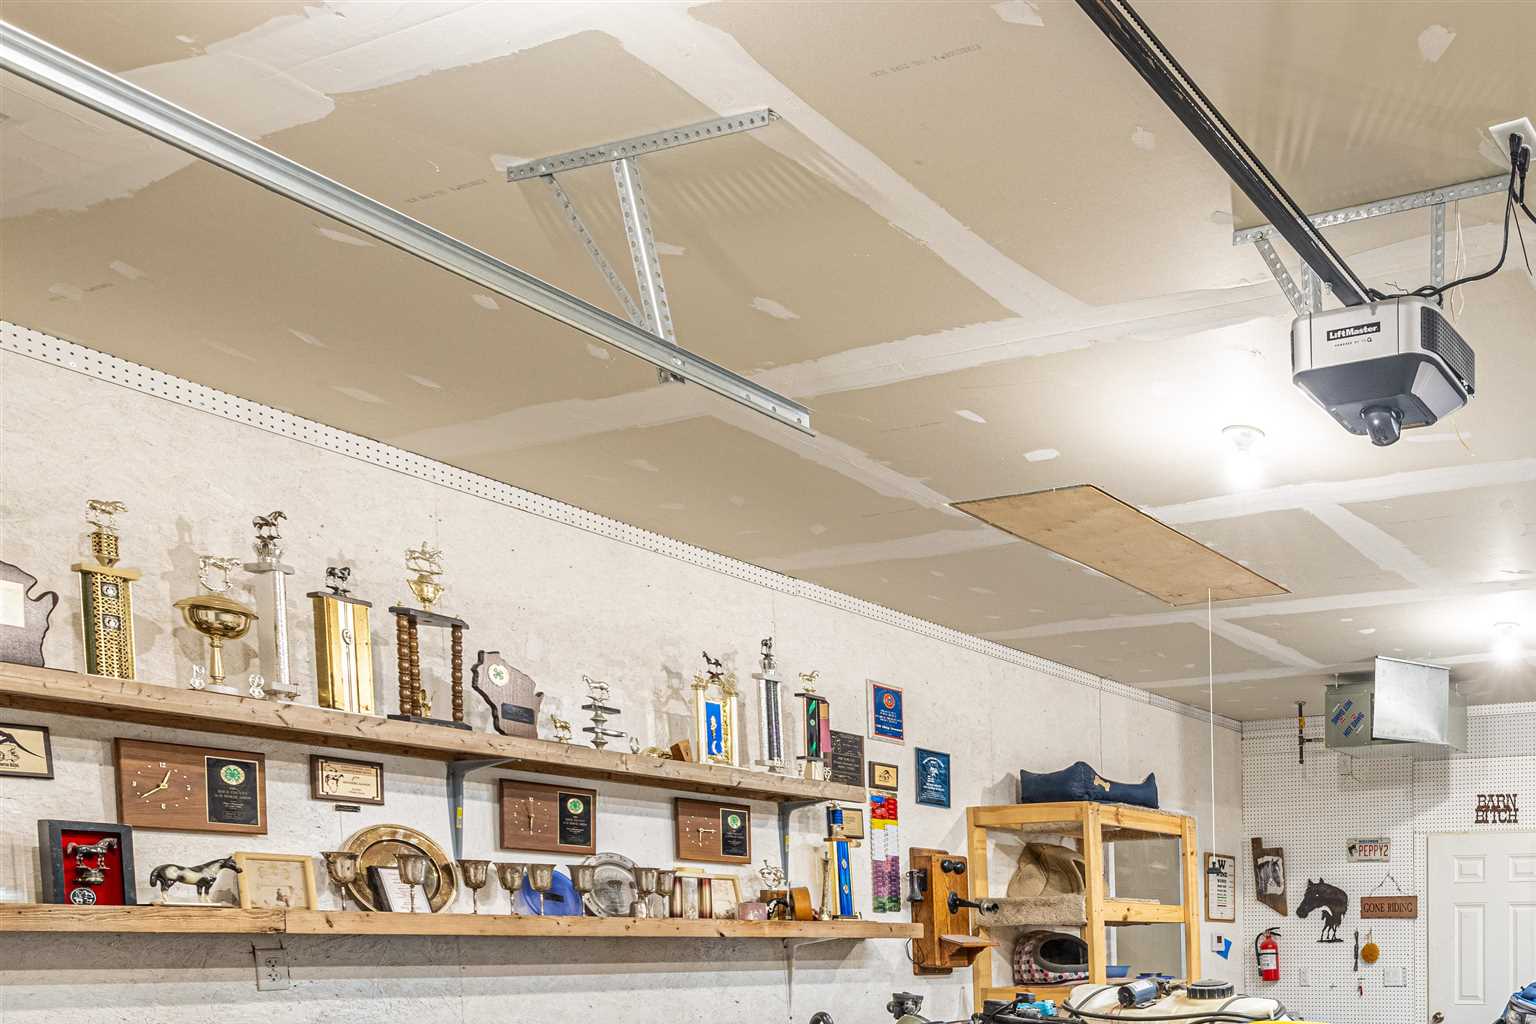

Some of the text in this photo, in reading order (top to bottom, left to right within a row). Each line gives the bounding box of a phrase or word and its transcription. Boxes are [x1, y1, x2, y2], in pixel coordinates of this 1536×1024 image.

[1329, 326, 1378, 339] LiftMaster
[1476, 794, 1519, 811] BARN
[1475, 808, 1519, 823] BITCH
[1359, 844, 1389, 857] PEPPY2
[1363, 902, 1413, 913] GONE RIDING
